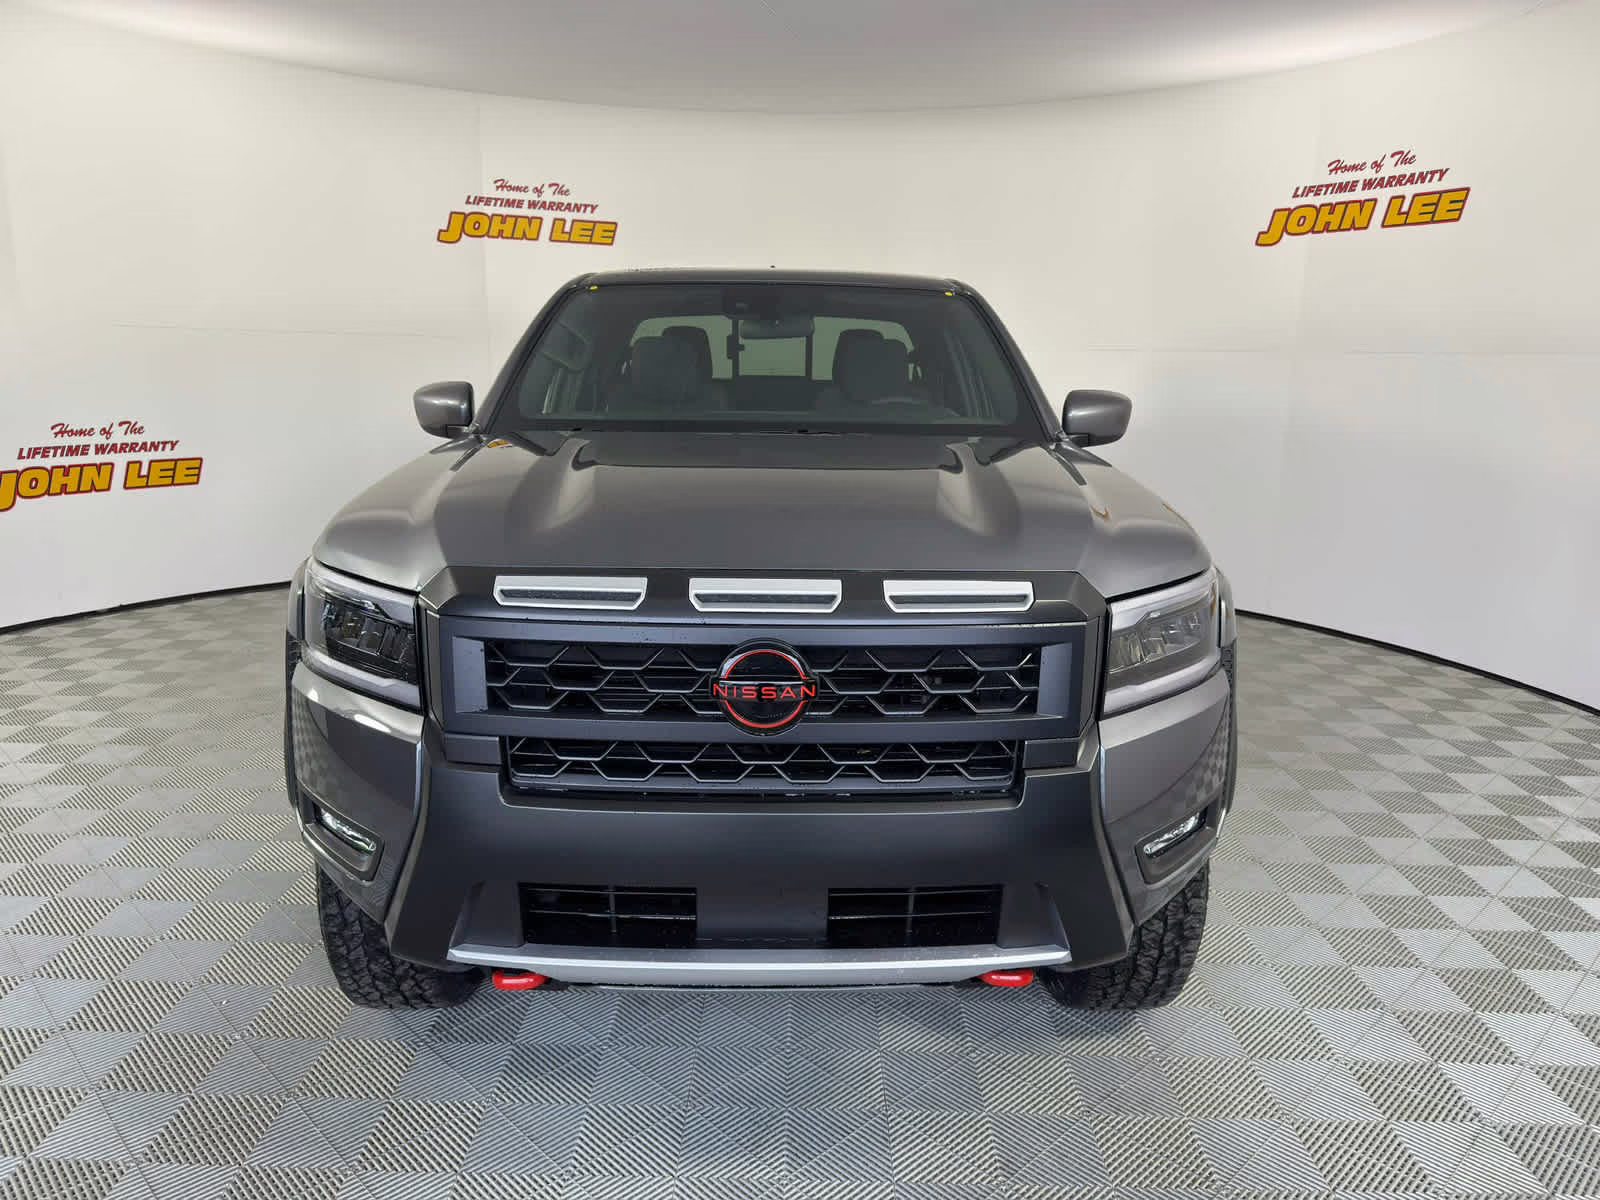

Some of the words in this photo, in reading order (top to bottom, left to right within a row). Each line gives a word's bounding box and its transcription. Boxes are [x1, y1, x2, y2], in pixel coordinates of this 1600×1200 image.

[1327, 159, 1367, 175] Home
[1370, 154, 1386, 174] of
[1390, 150, 1416, 167] The
[493, 178, 529, 193] Home
[532, 184, 544, 198] of
[548, 183, 570, 196] The
[1292, 179, 1359, 198] LIFETIME
[1361, 168, 1450, 191] WARRANTY
[465, 195, 524, 209] LIFETIME
[528, 200, 599, 214] WARRANTY
[1255, 198, 1378, 246] JOHN
[1381, 187, 1471, 228] LEE
[437, 211, 543, 244] JOHN
[549, 218, 618, 246] LEE
[50, 423, 95, 438] Home
[100, 423, 114, 440] of
[118, 421, 144, 436] The
[17, 444, 91, 460] LIFETIME
[94, 440, 179, 456] WARRANTY
[123, 457, 203, 490] LEE
[713, 684, 816, 699] NISSAN
